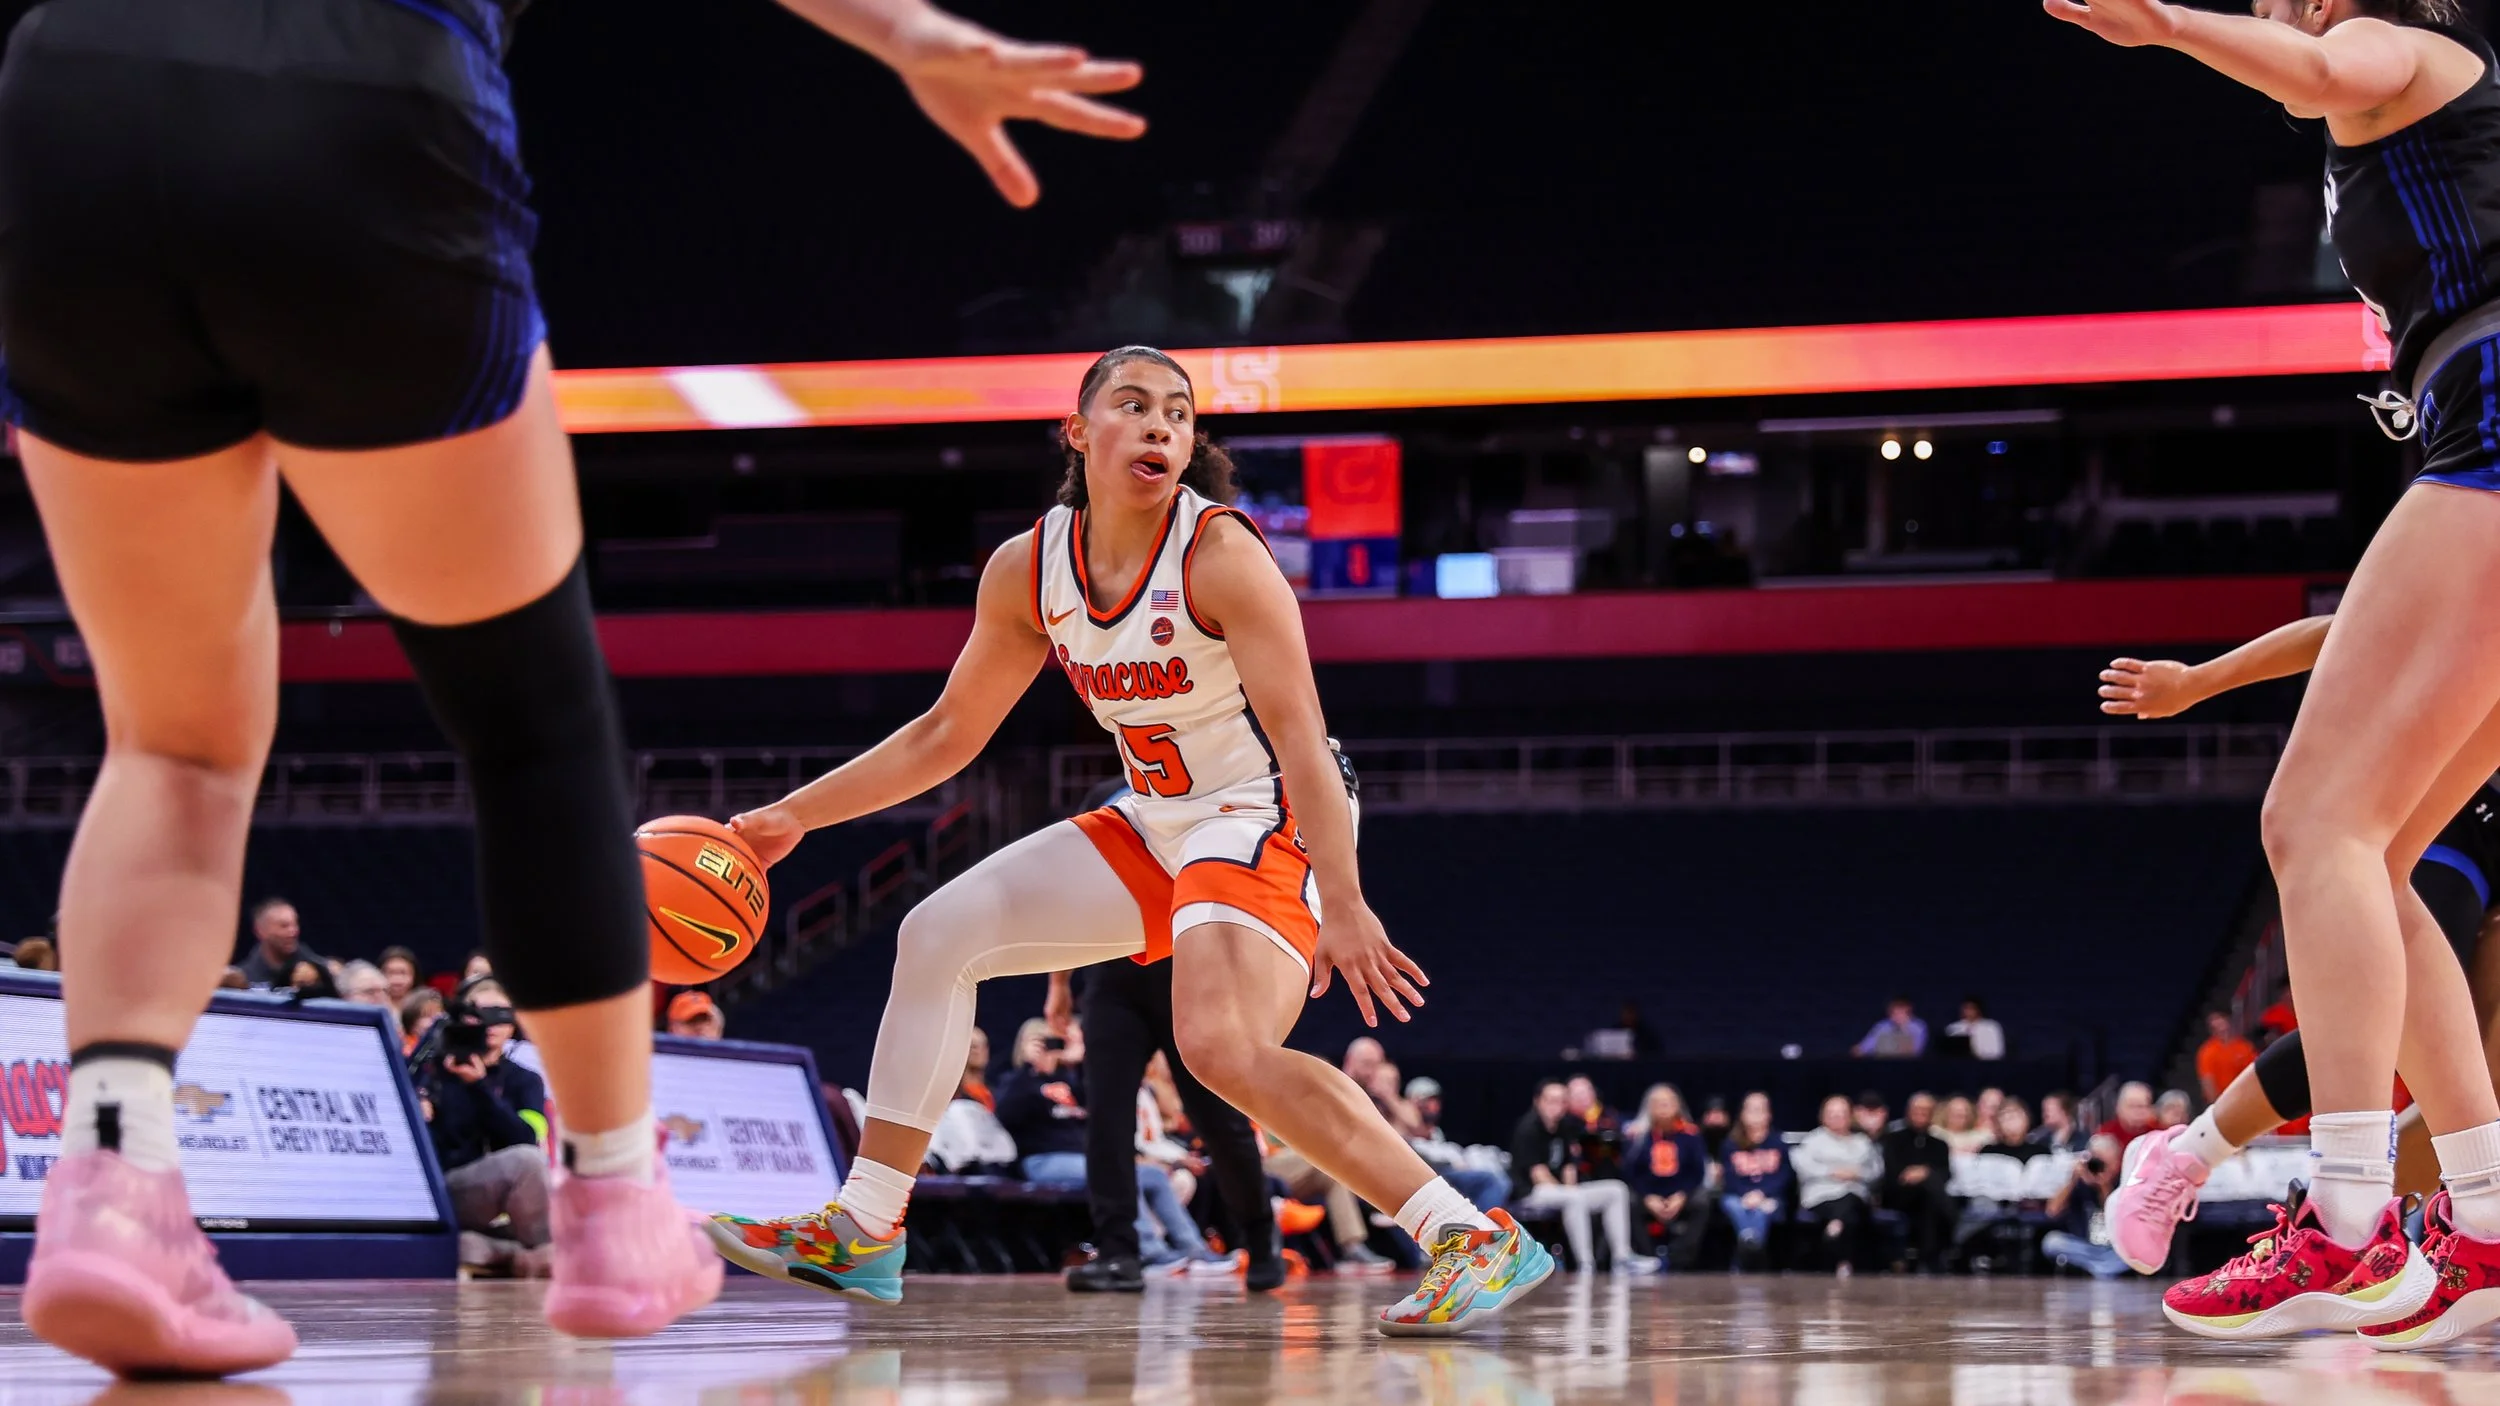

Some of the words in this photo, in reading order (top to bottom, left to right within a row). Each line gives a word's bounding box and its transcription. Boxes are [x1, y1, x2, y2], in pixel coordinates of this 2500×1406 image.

[695, 841, 765, 918] ELITE
[256, 1085, 352, 1123] CENTRAL
[349, 1091, 381, 1125] NY
[178, 1133, 248, 1151] HEVROLET
[269, 1126, 325, 1153] CHEVY
[323, 1127, 392, 1155] DEALERS
